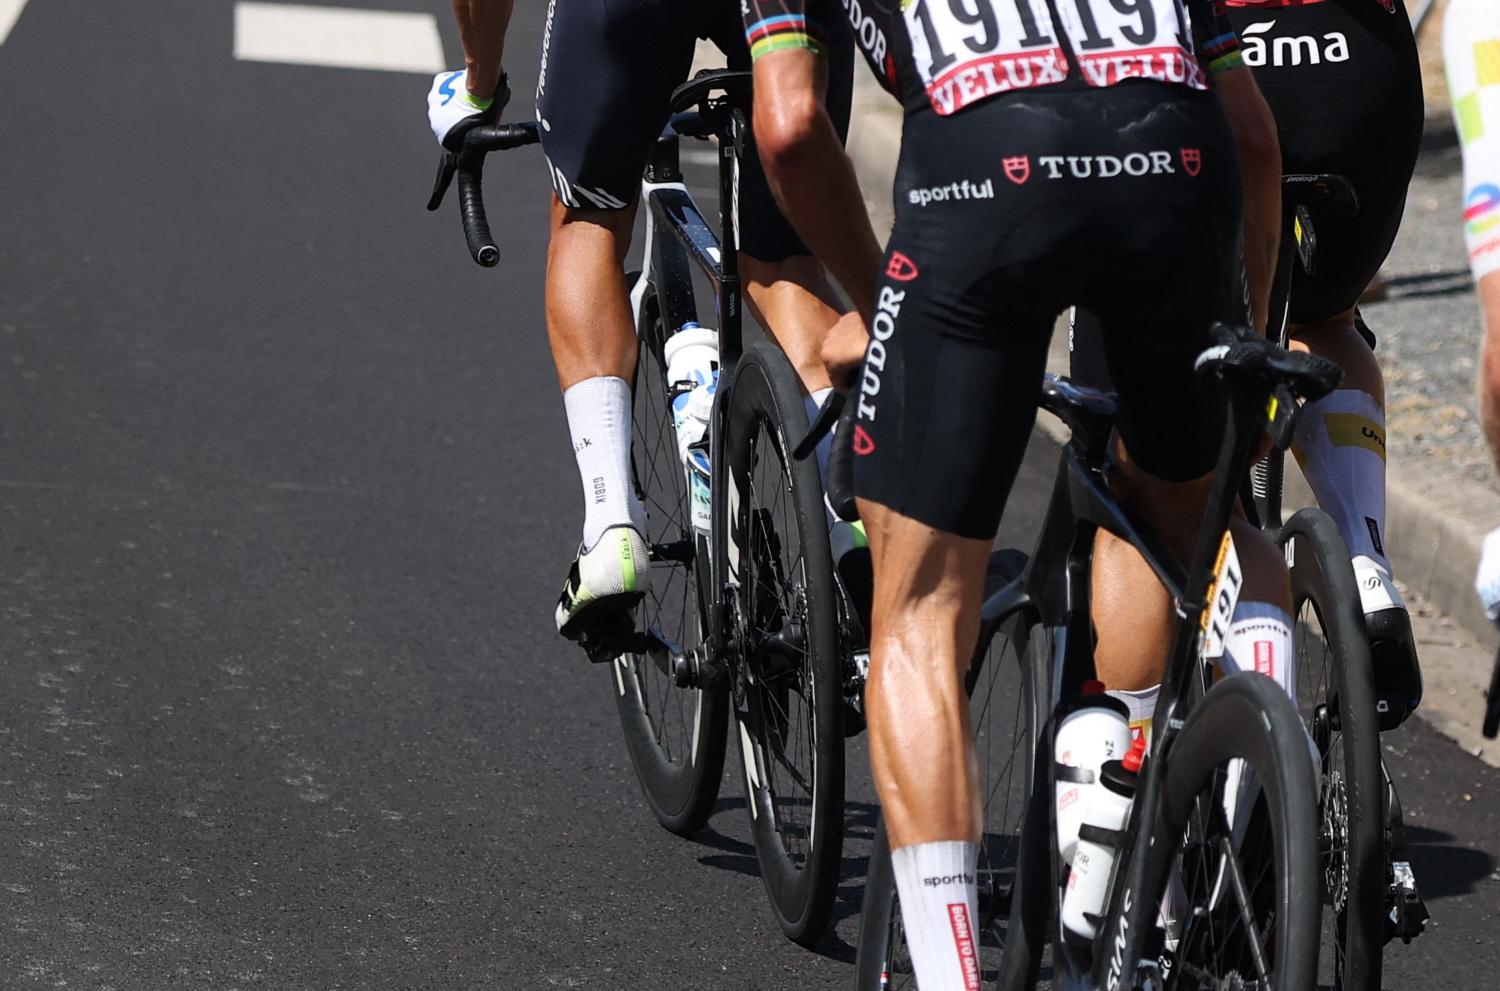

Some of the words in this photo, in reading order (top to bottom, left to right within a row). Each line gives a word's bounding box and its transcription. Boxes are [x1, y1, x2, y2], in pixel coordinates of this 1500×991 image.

[931, 53, 1059, 115] VELUX
[908, 179, 995, 207] sportful
[1039, 150, 1176, 180] TUDOR
[856, 285, 906, 423] TUDOR
[1212, 564, 1238, 642] 191
[951, 905, 969, 939] BORN
[960, 939, 973, 956] TO
